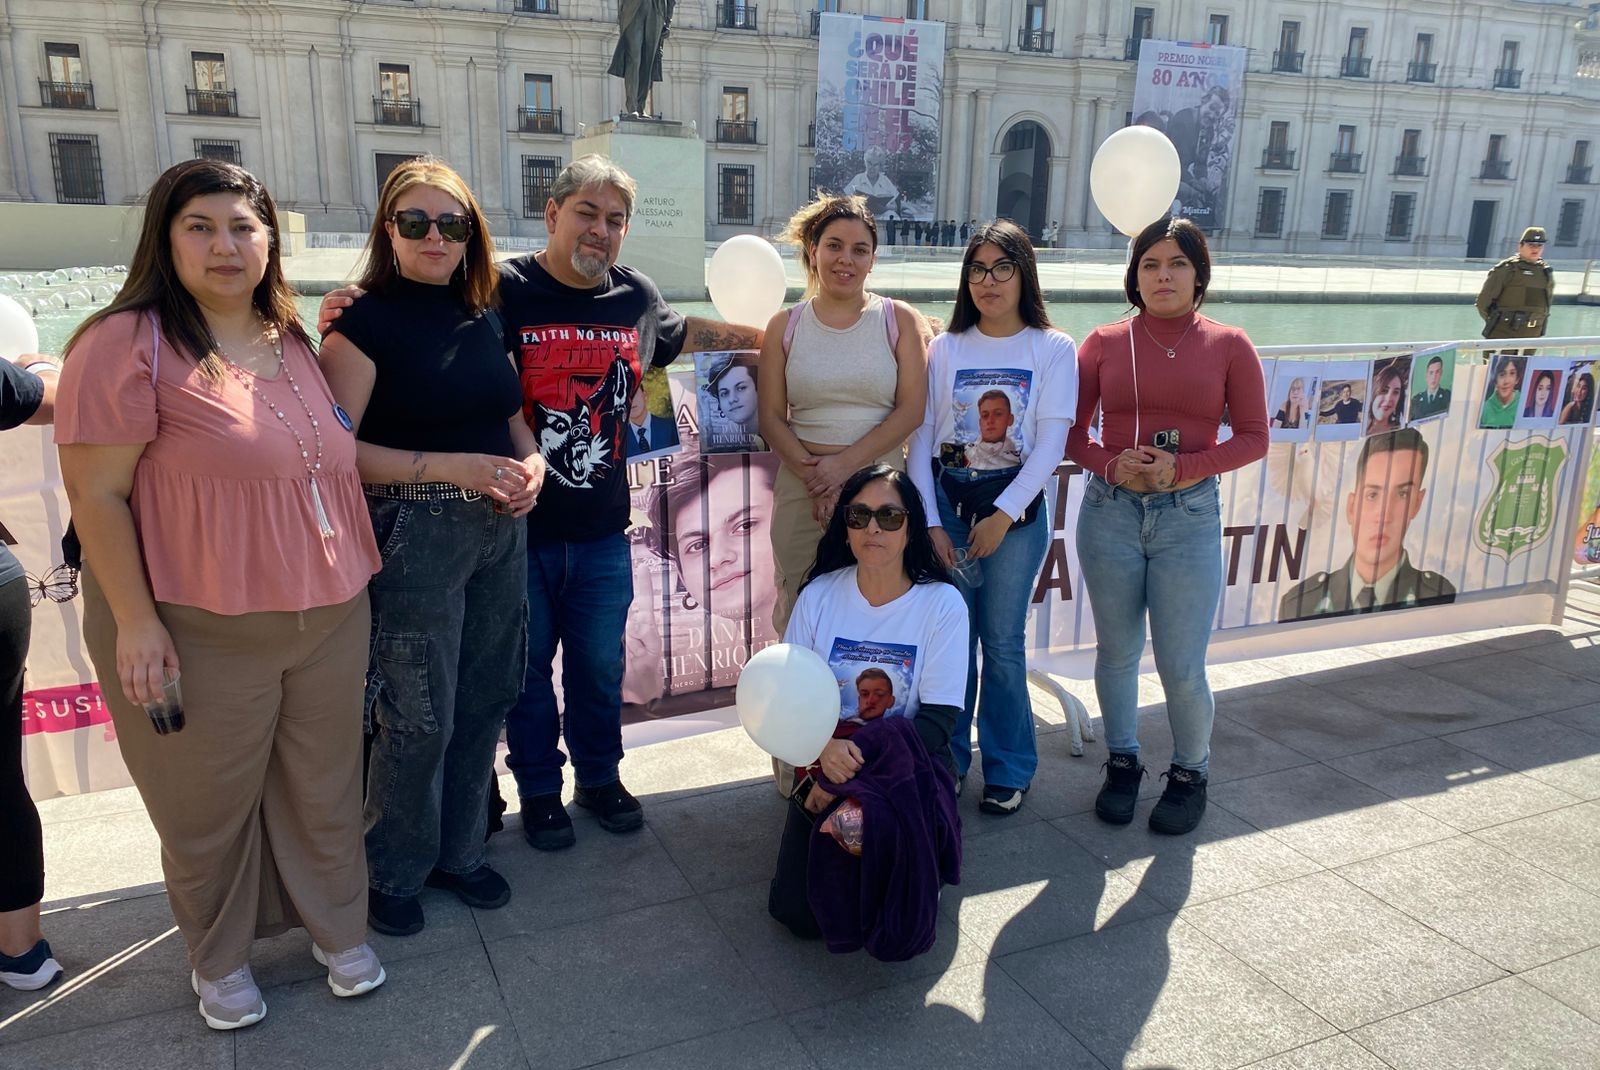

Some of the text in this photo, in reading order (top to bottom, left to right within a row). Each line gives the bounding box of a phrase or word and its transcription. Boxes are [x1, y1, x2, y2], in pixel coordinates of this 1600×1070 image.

[847, 29, 919, 62] ¿QUÉ
[1158, 52, 1195, 64] PREMIO
[846, 60, 917, 81] SERÁ DE
[1152, 68, 1172, 86] 80
[845, 79, 916, 106] CHILE
[643, 197, 675, 206] ARTURO
[636, 208, 683, 217] ALESSANDRI
[645, 219, 673, 228] PALMA
[522, 329, 637, 343] FAITH NO MORE
[688, 617, 763, 649] DANTE
